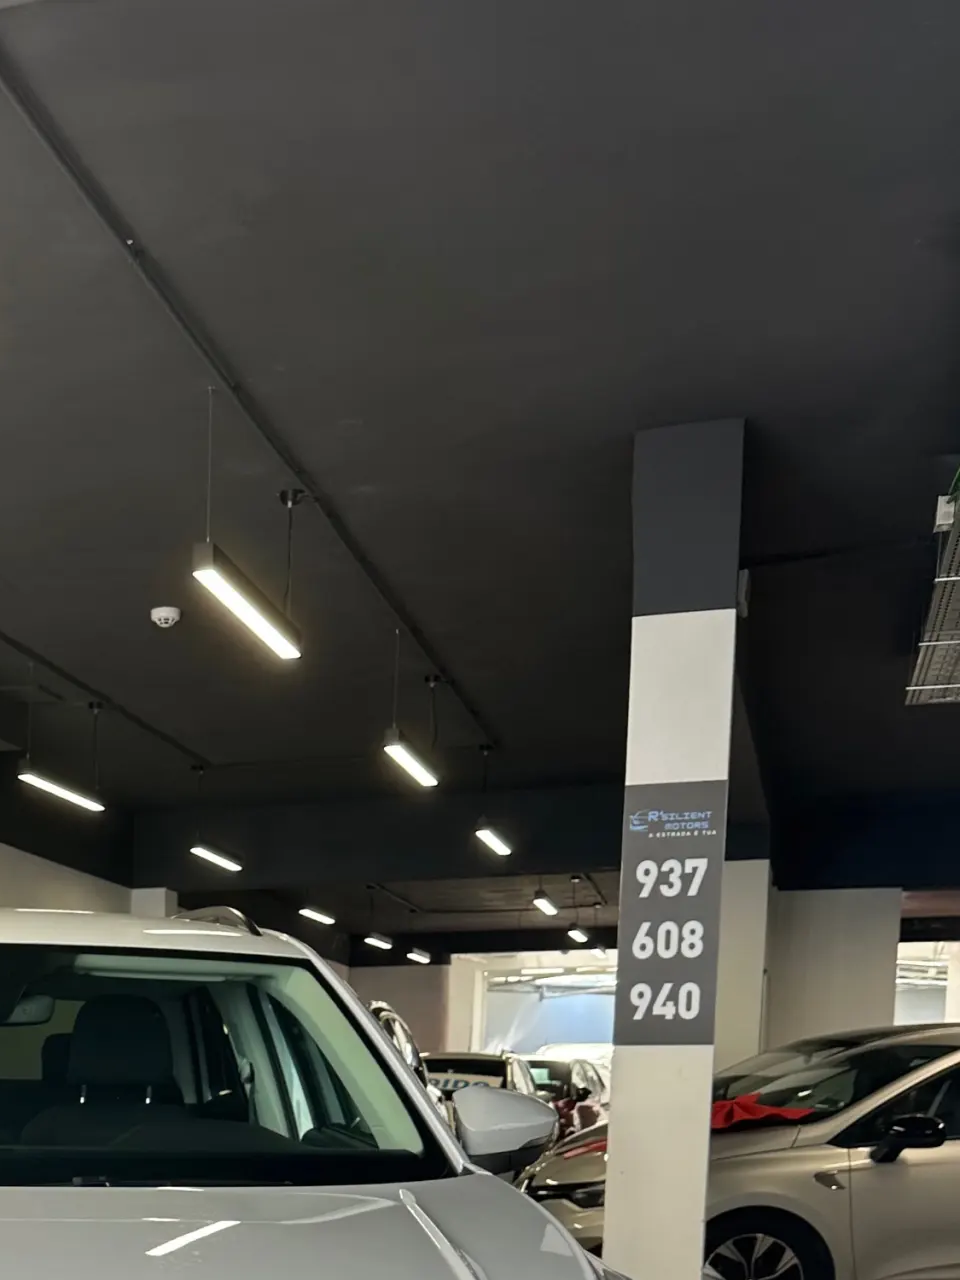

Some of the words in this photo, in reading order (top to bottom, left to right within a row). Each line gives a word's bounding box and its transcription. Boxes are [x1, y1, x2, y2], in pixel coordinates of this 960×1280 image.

[664, 820, 709, 830] MOTORS
[702, 828, 717, 836] TUA
[635, 857, 708, 898] 937
[632, 920, 704, 960] 608
[630, 982, 701, 1020] 940
